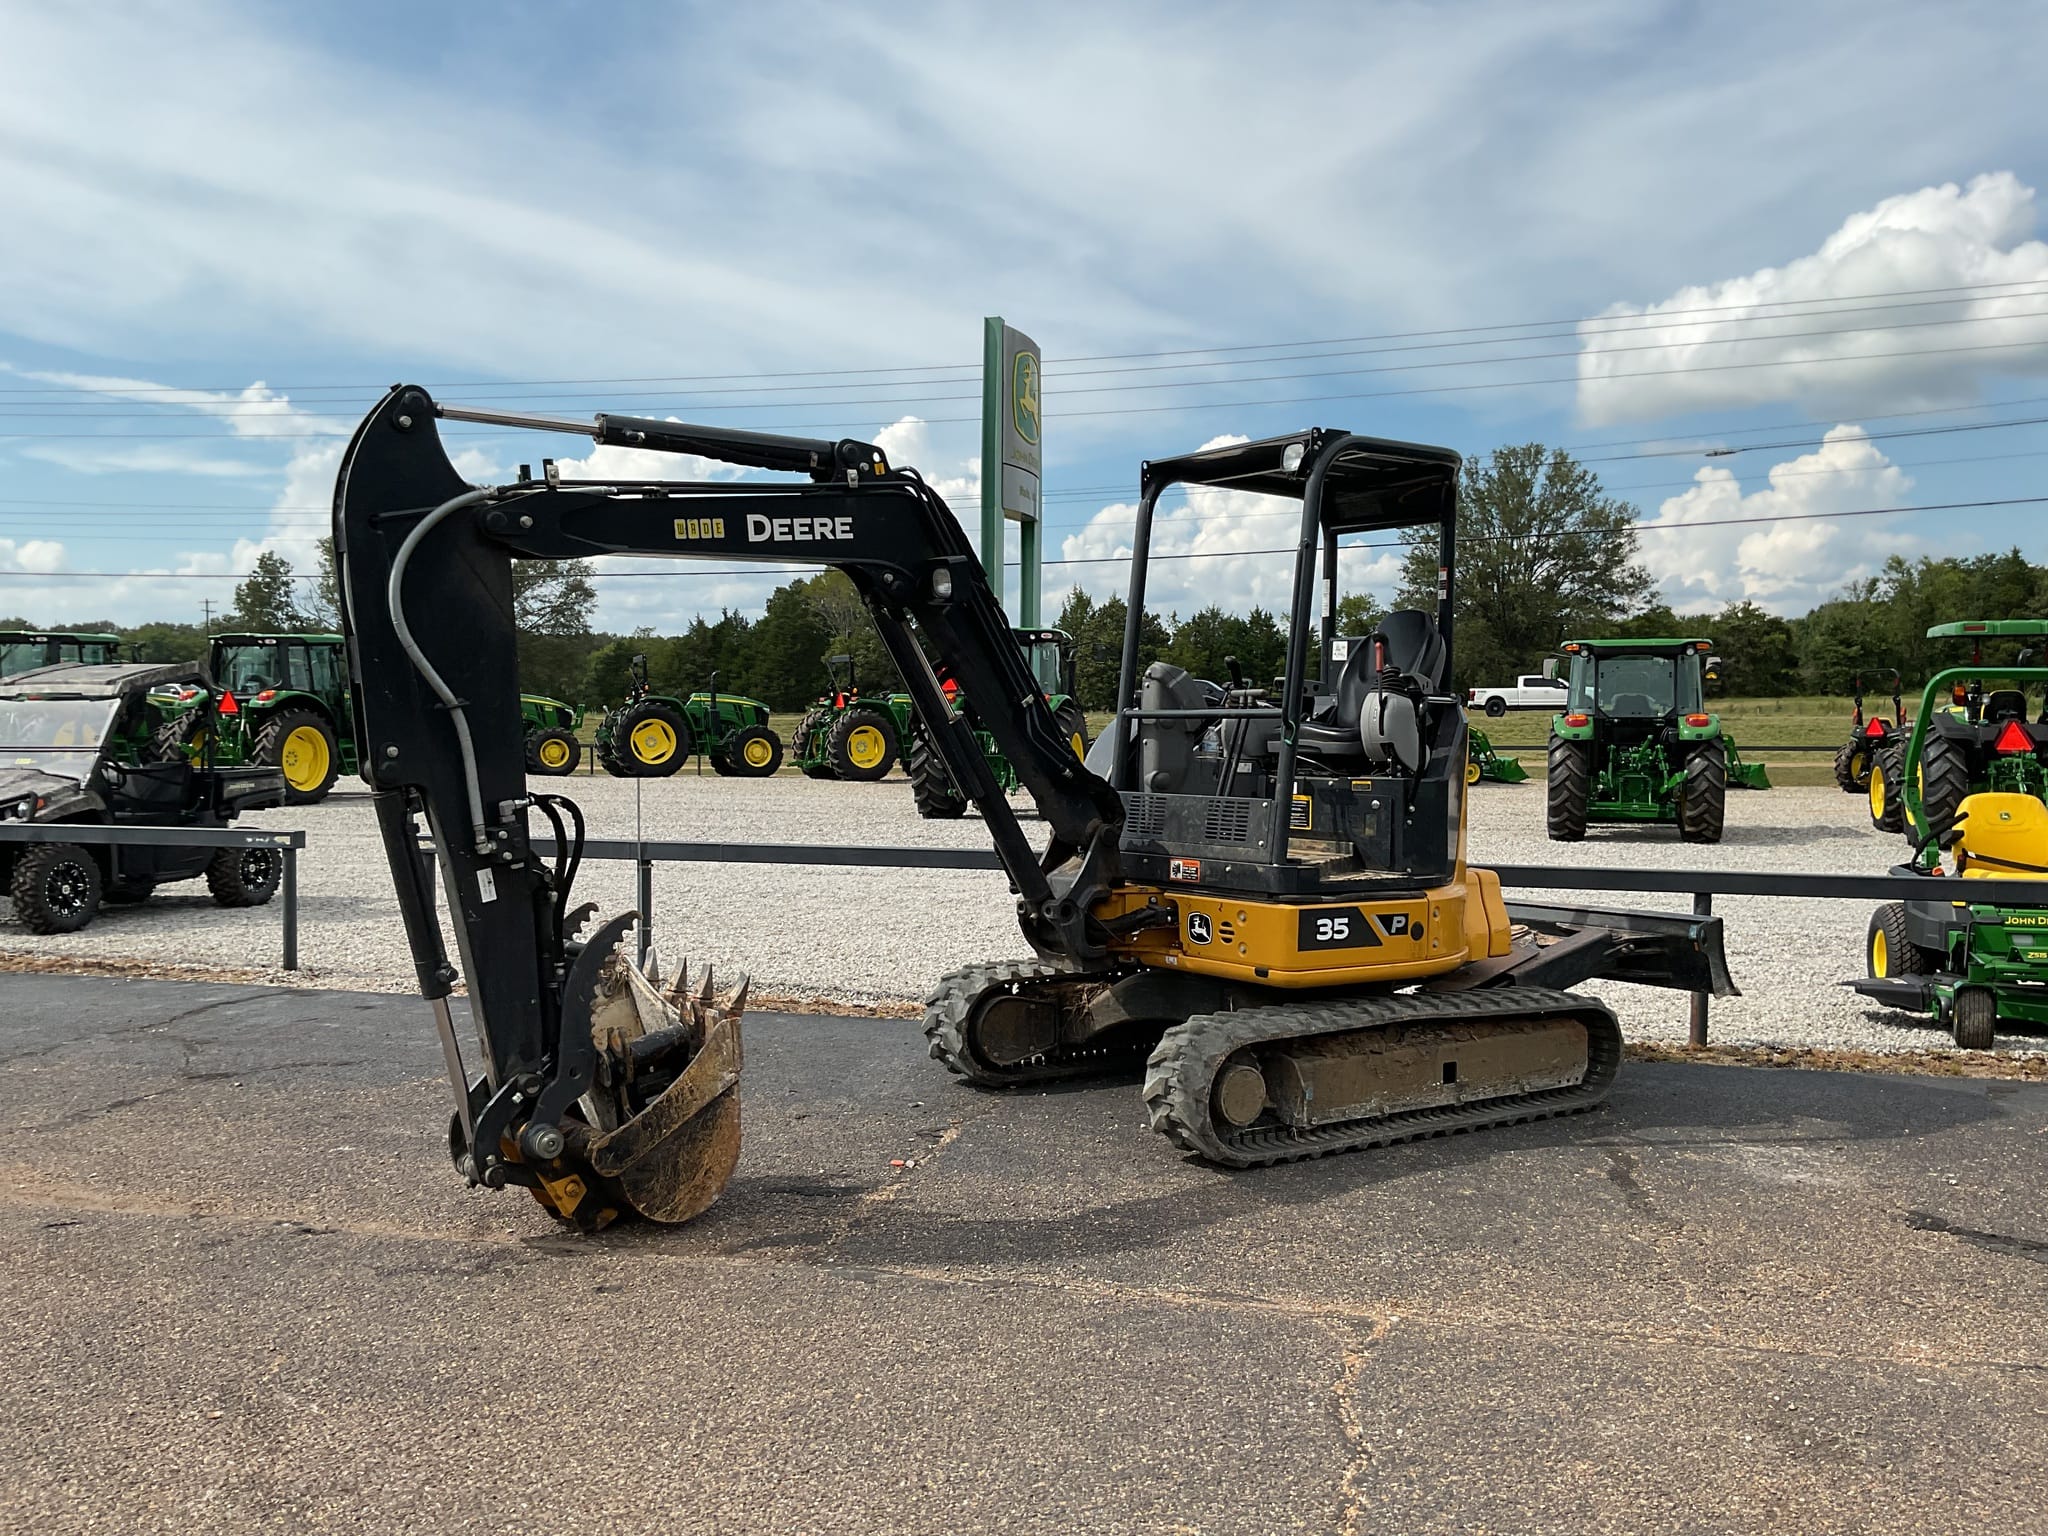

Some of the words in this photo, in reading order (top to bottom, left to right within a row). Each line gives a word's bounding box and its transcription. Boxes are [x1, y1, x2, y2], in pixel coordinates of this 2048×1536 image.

[675, 520, 724, 537] WADE
[746, 514, 854, 542] DEERE
[1316, 917, 1349, 941] 35
[1391, 916, 1406, 934] P
[2004, 916, 2036, 925] JOHN
